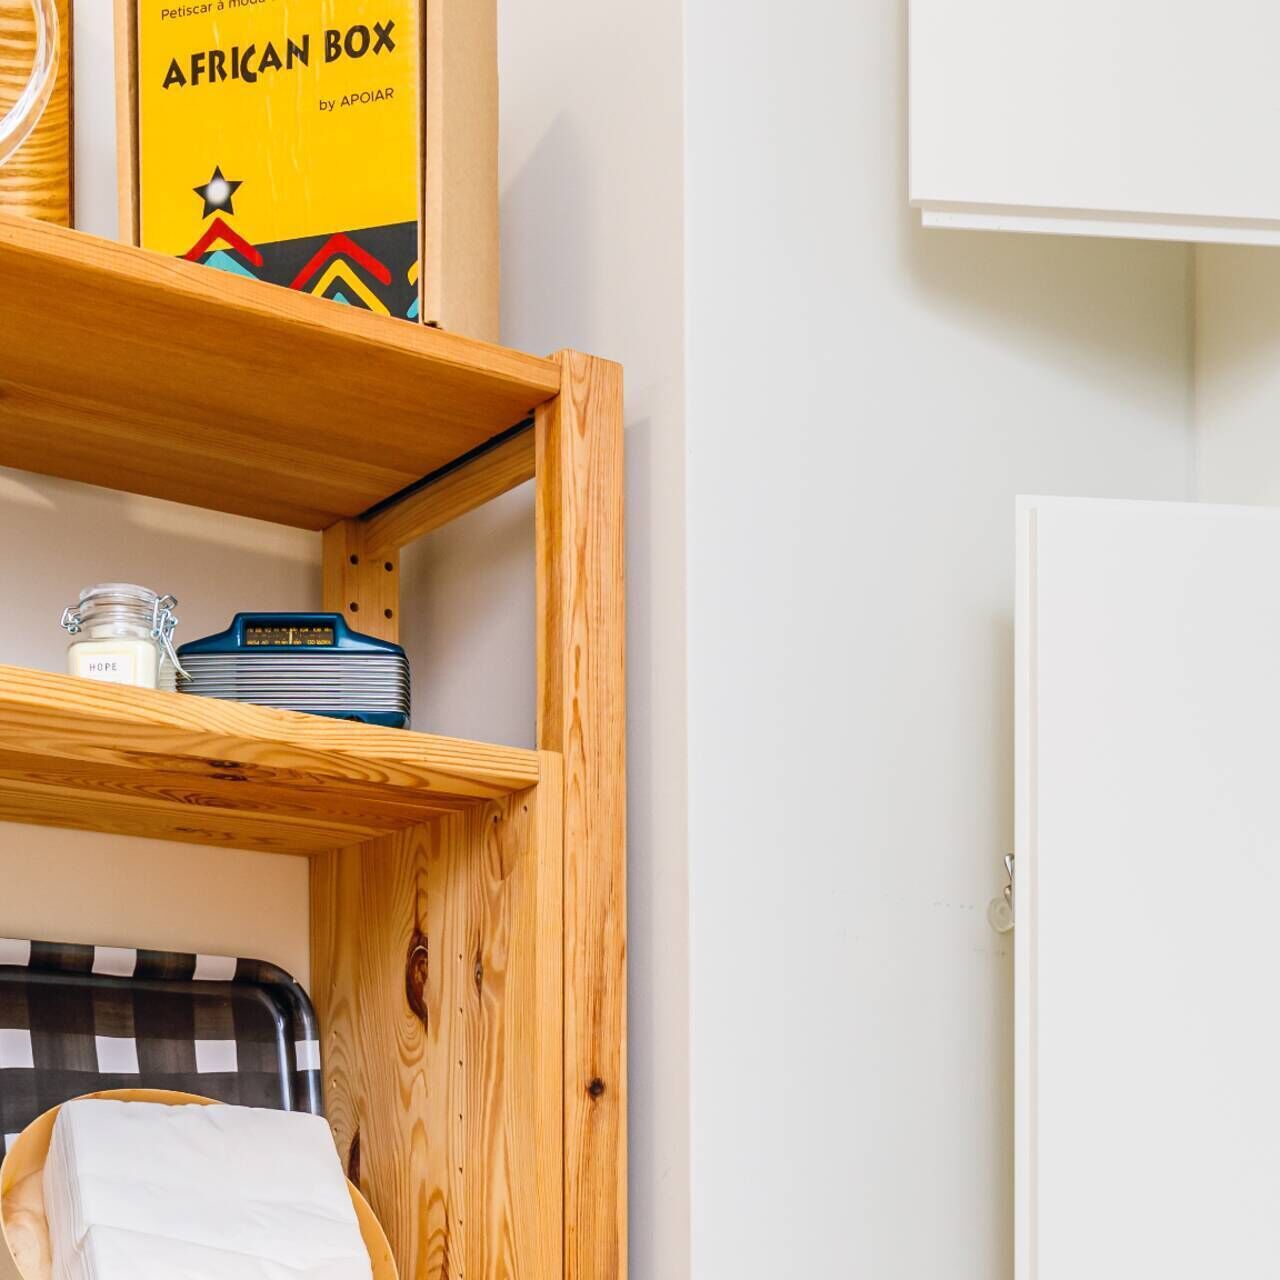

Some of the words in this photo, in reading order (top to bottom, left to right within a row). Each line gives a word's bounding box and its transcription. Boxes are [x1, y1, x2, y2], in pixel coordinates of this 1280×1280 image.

[161, 4, 211, 21] Petiscar
[162, 34, 310, 90] AFRICAN
[324, 19, 396, 64] BOX
[320, 98, 336, 112] by
[340, 87, 395, 108] APOIAR
[89, 662, 117, 672] HOPE
